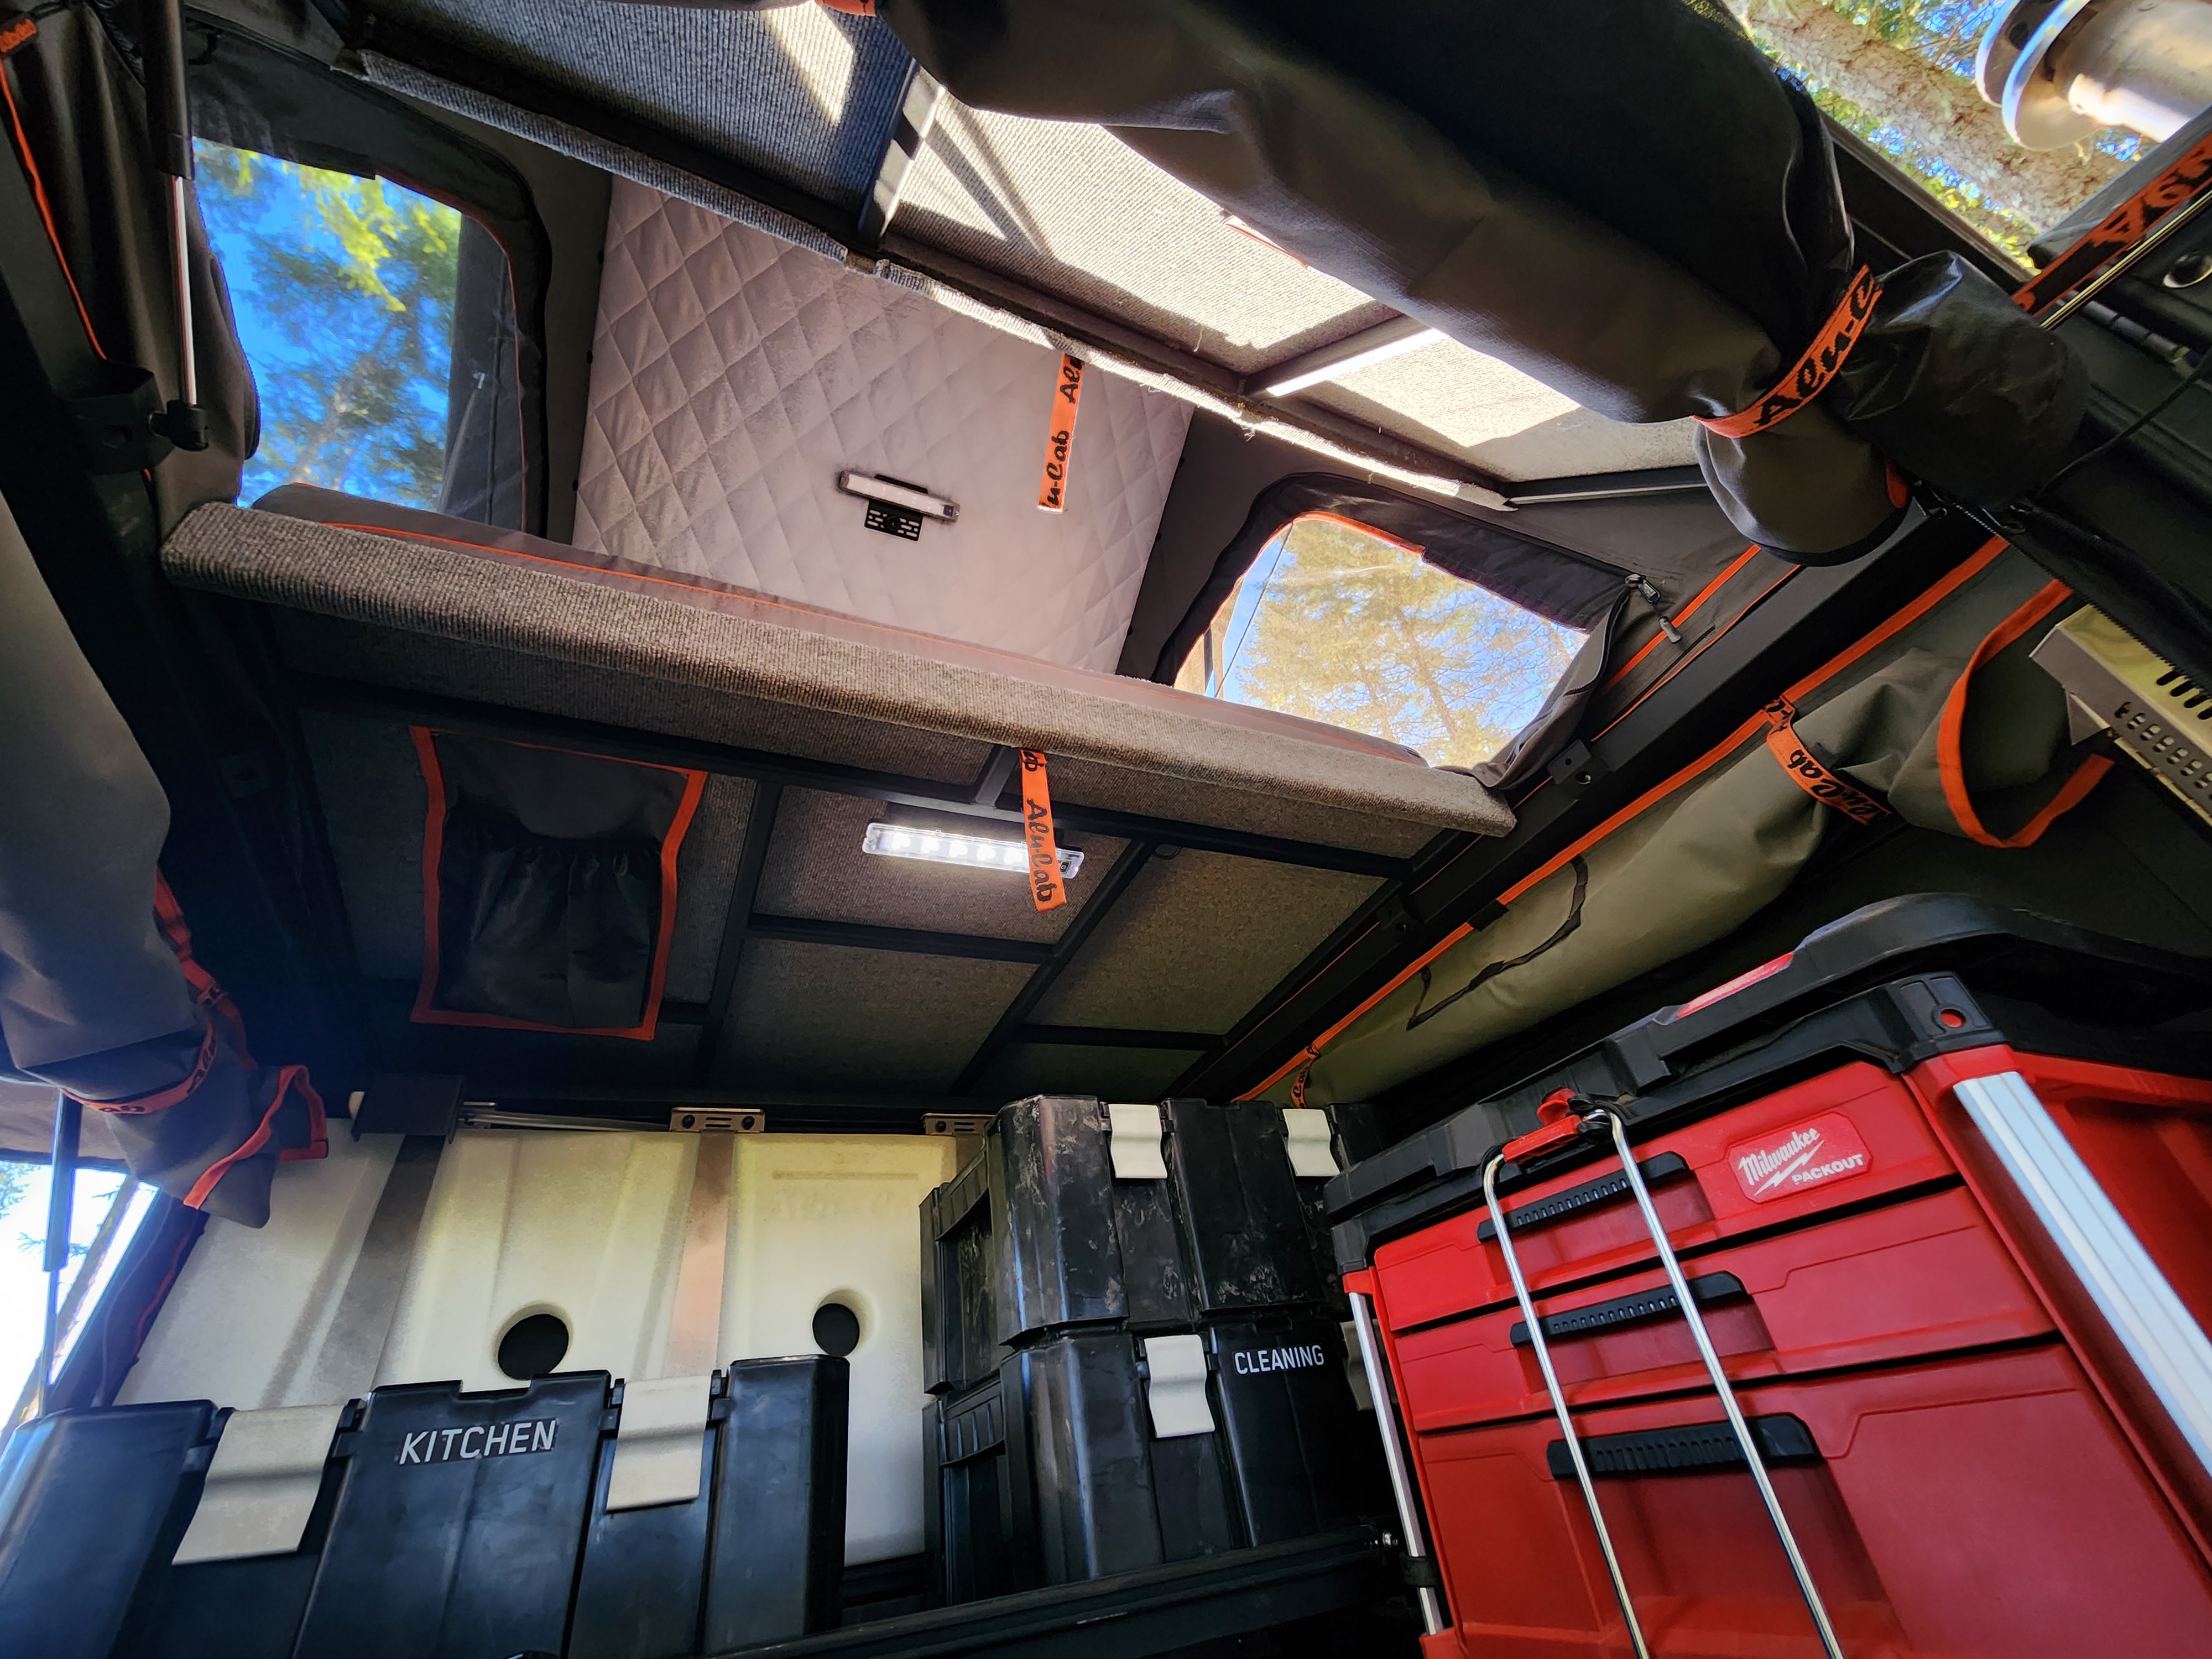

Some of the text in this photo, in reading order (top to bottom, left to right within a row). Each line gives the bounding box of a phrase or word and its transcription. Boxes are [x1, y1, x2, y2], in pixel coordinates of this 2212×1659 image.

[1041, 430, 1070, 507] u-Cab
[1026, 799, 1057, 902] Alu-Cab
[1738, 1128, 1820, 1185] Milwaukee
[1792, 1154, 1864, 1185] PACKOUT
[1234, 1345, 1324, 1374] CLEANING
[399, 1420, 556, 1465] KITCHEN
